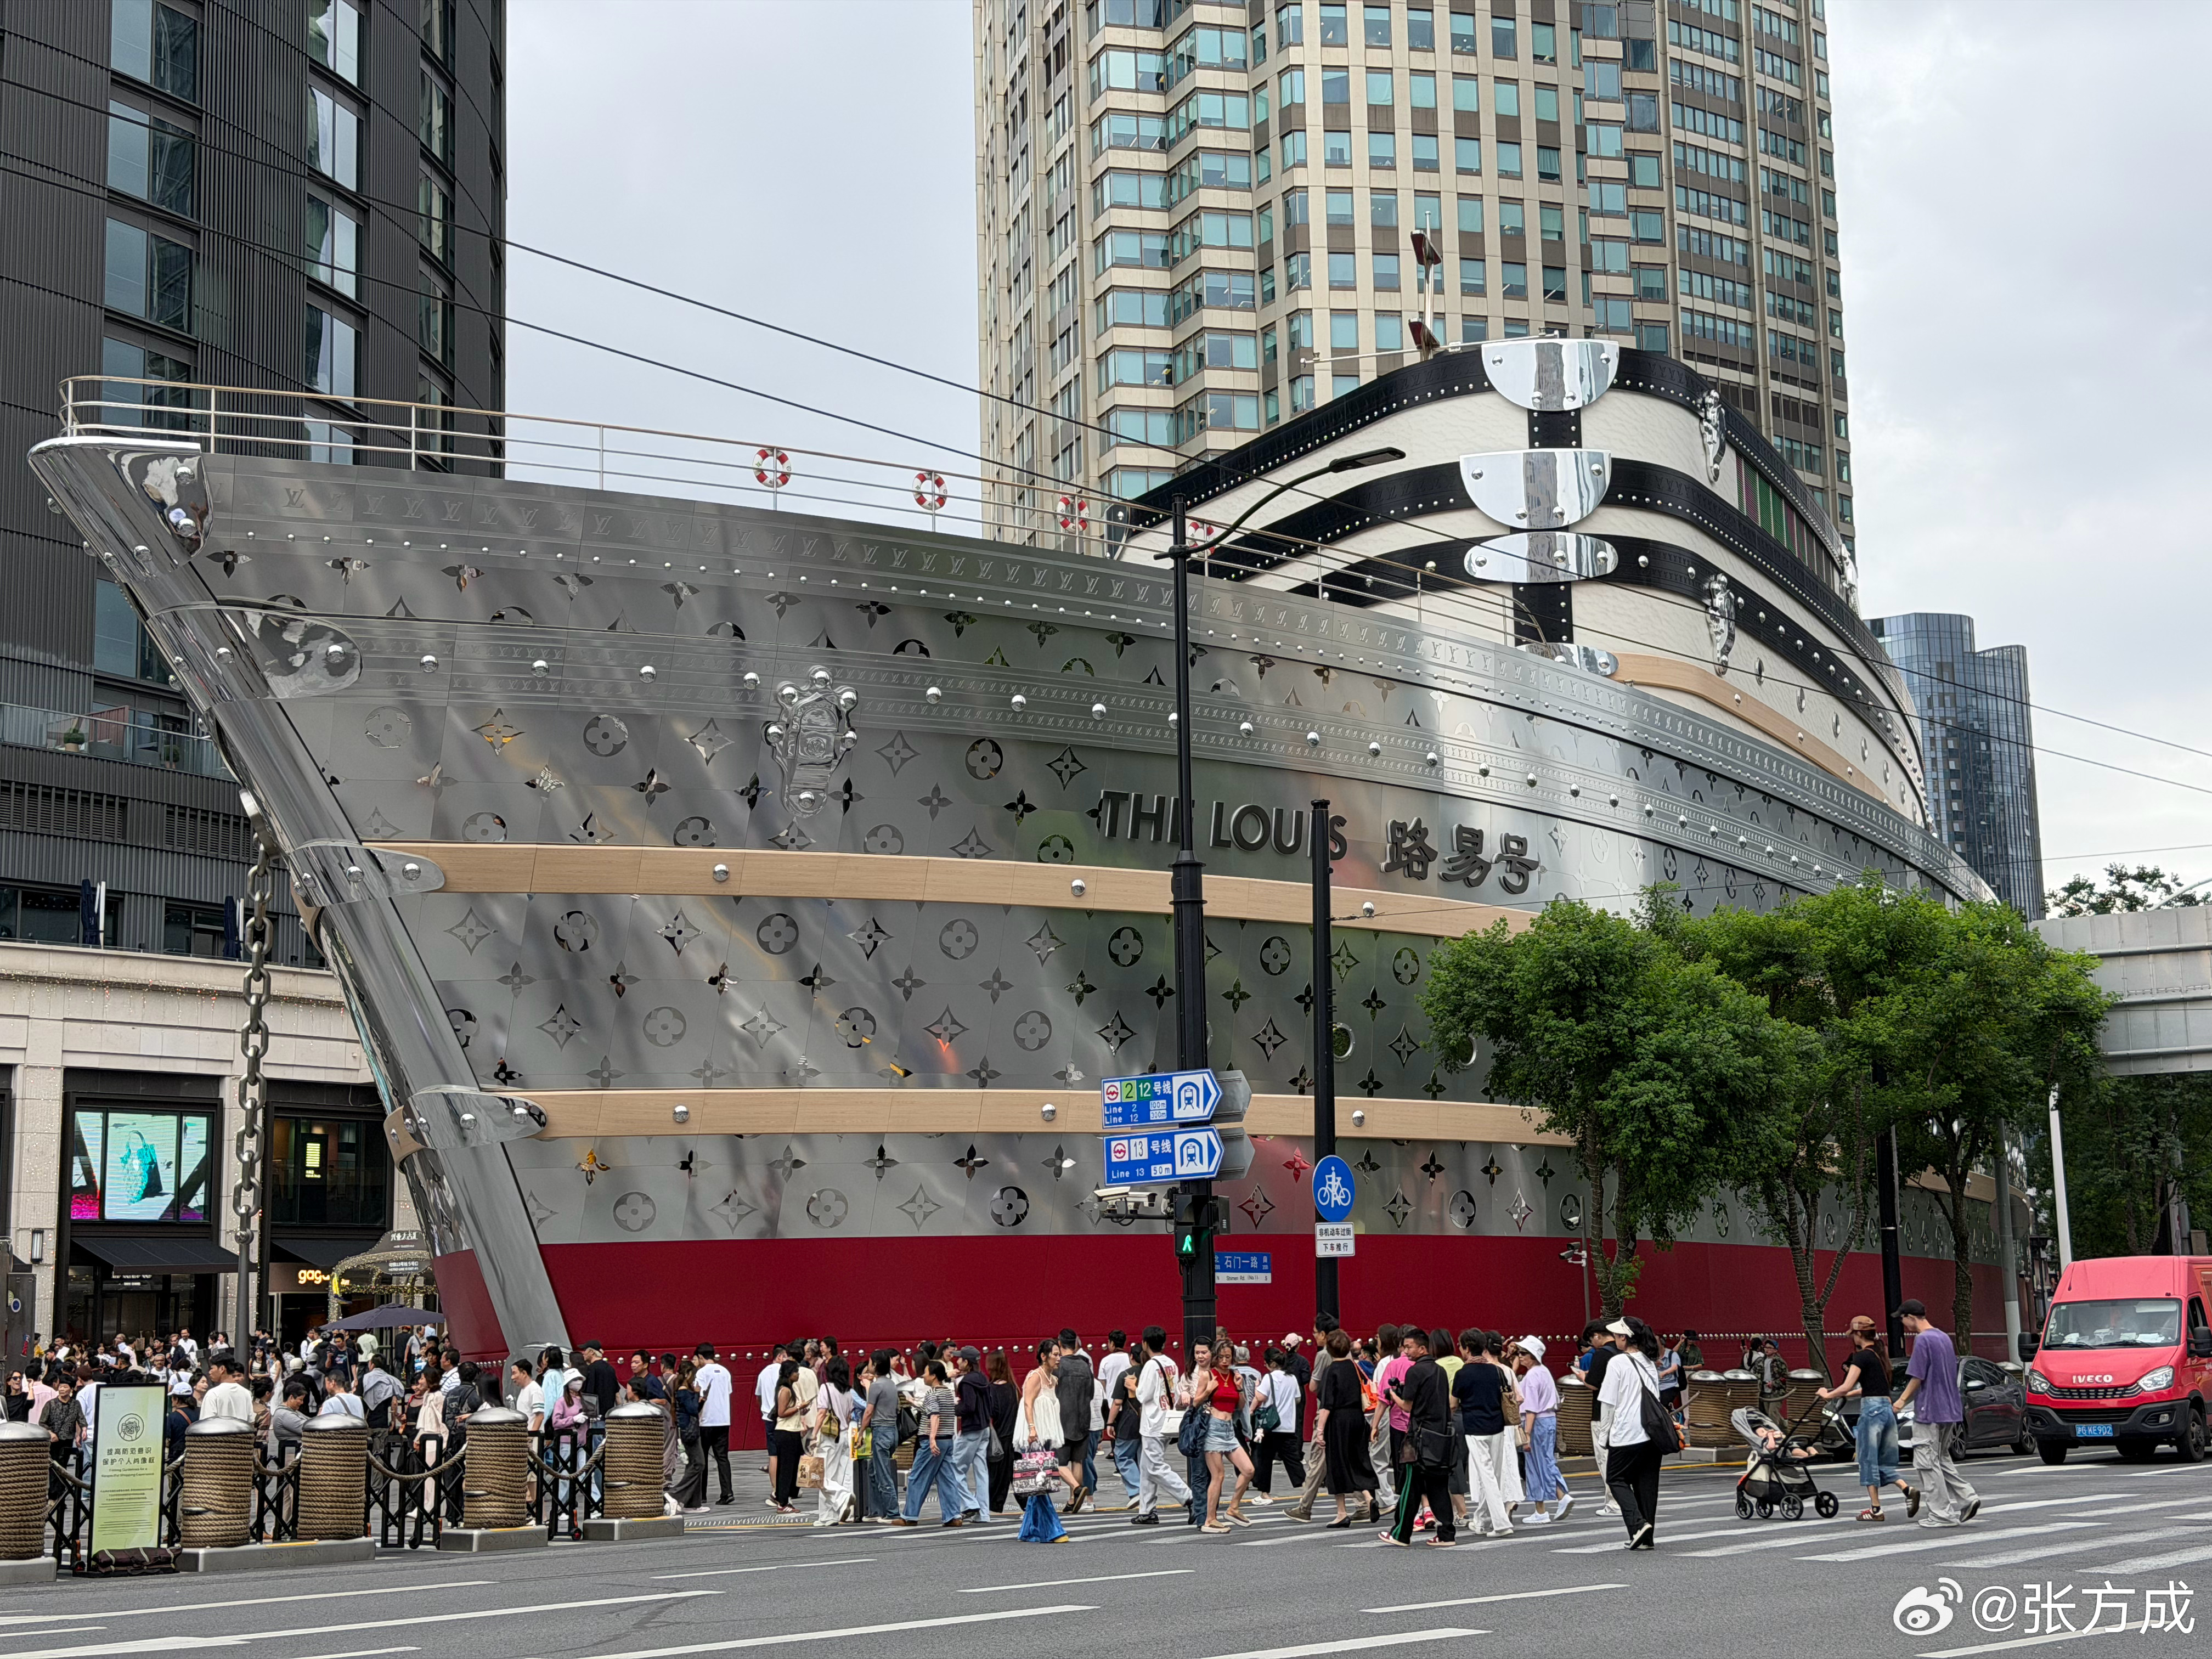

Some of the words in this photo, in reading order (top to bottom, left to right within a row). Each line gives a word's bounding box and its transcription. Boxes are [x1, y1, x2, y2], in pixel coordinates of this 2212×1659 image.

[1210, 801, 1347, 860] LOUS
[1380, 816, 1539, 895] 路易号
[1125, 1083, 1133, 1099] 2
[1139, 1082, 1151, 1097] 12
[1153, 1080, 1172, 1095] 号线
[1105, 1105, 1122, 1114] Line
[1105, 1115, 1122, 1124] Line
[1130, 1114, 1138, 1122] 12
[1134, 1141, 1143, 1157] 13
[1150, 1139, 1171, 1154] 号线
[1111, 1170, 1130, 1178] Line
[1136, 1168, 1144, 1176] 13
[1319, 1227, 1351, 1237] 非机动车过街
[1323, 1243, 1348, 1252] 下车推行
[1224, 1256, 1258, 1268] 石门一路
[2073, 1375, 2113, 1383] IVECO
